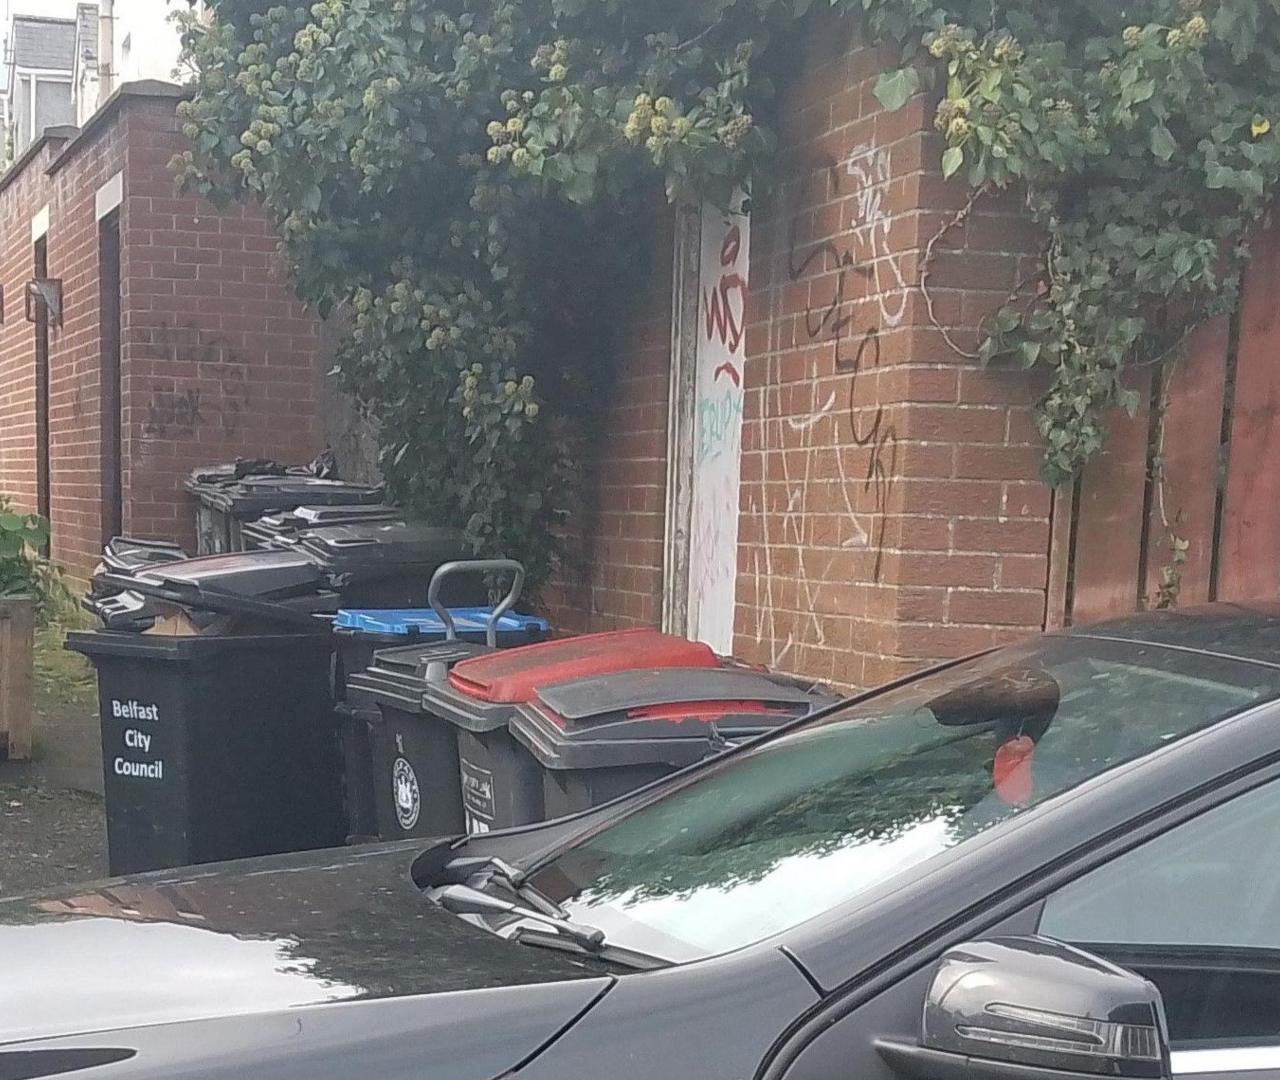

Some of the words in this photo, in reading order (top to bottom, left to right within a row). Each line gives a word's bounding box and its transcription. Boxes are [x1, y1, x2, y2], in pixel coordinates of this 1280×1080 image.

[112, 699, 159, 721] Belfast
[124, 728, 151, 753] City
[114, 757, 163, 779] Council
